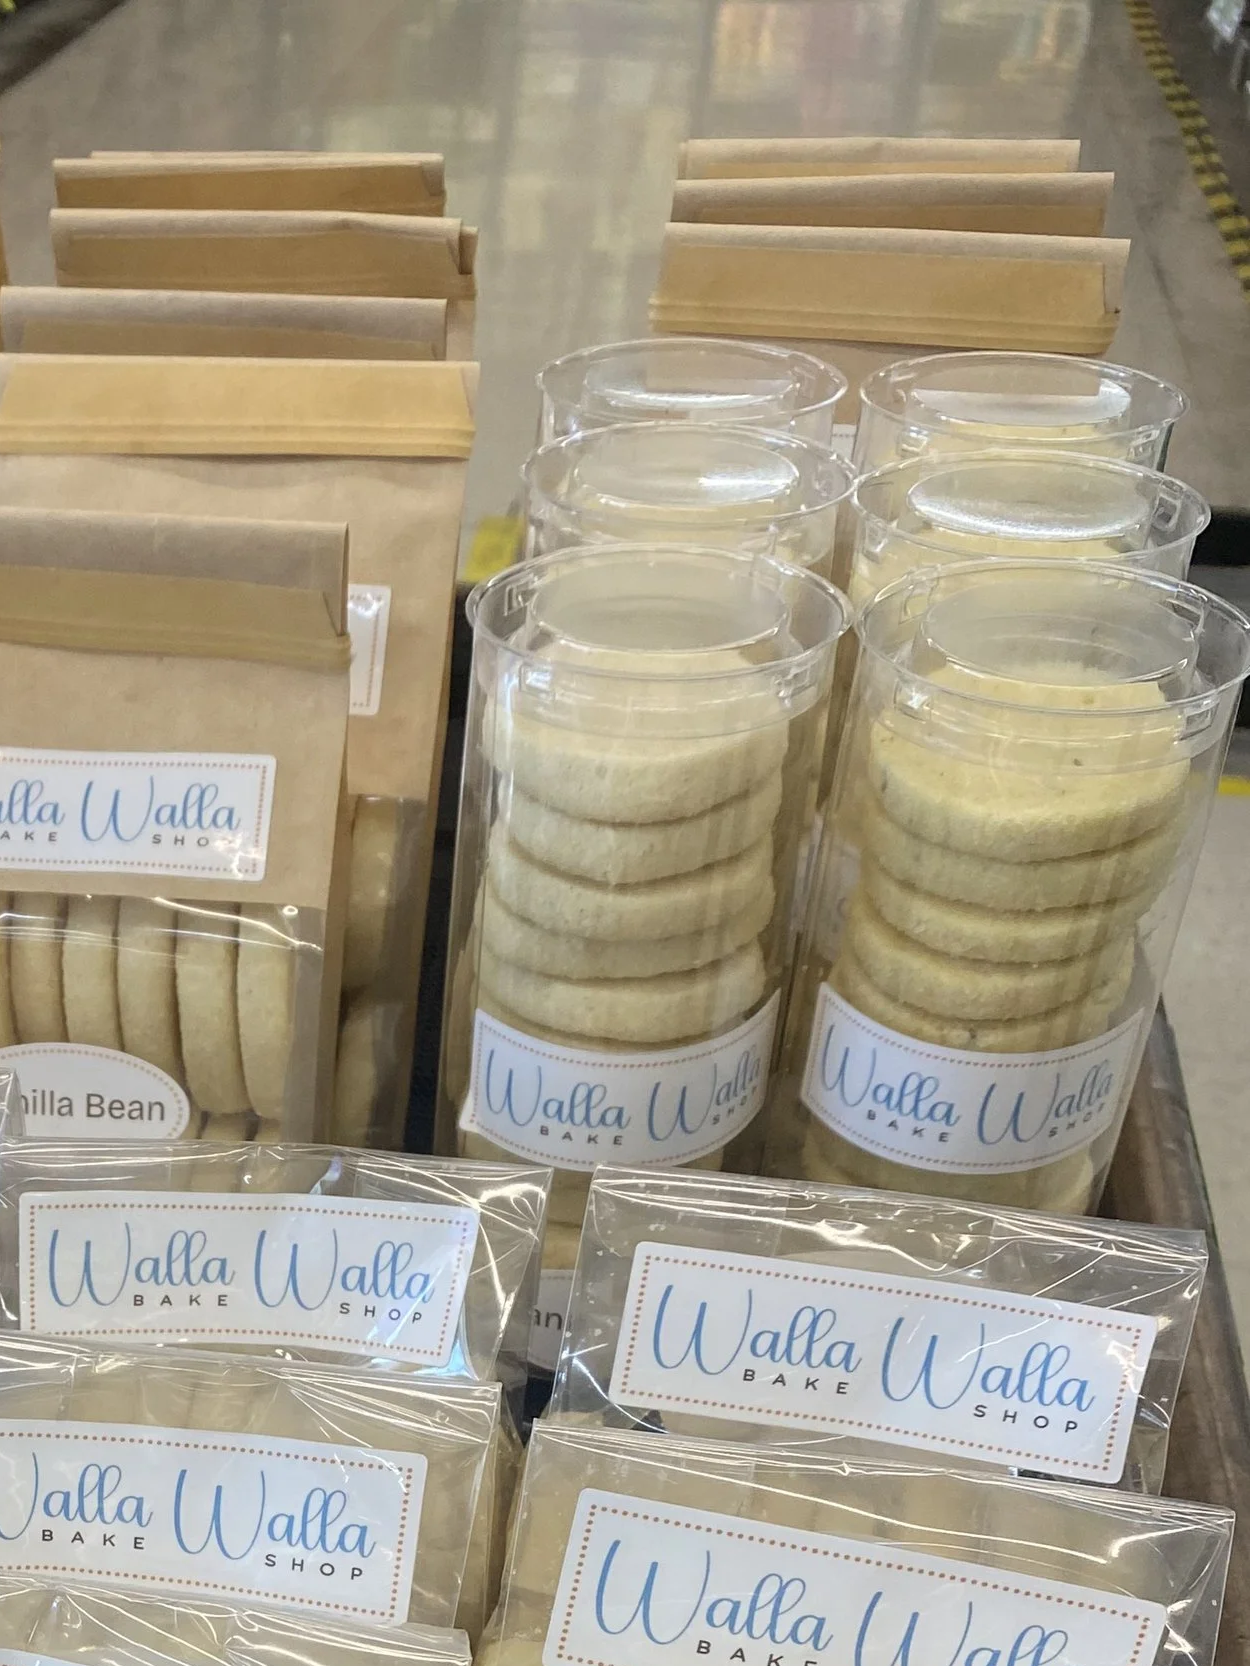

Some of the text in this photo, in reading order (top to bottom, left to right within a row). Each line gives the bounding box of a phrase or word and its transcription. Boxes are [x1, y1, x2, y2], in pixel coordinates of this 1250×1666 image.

[81, 775, 241, 843] Walla
[152, 833, 235, 849] SHO
[86, 1093, 166, 1121] Bean
[485, 1045, 761, 1142] Walla Walla
[821, 1023, 1112, 1145] Walla Walla
[540, 1125, 623, 1146] BAKE
[866, 1109, 952, 1143] BAKE
[48, 1223, 436, 1312] Walla Walla
[132, 1293, 423, 1325] BAKE SHOP
[651, 1282, 1096, 1413] Walla Walla
[742, 1367, 1080, 1435] BAKE SHOP
[173, 1468, 377, 1561] Walla
[41, 1528, 365, 1581] BAKE SHOP
[593, 1538, 833, 1654] Walla
